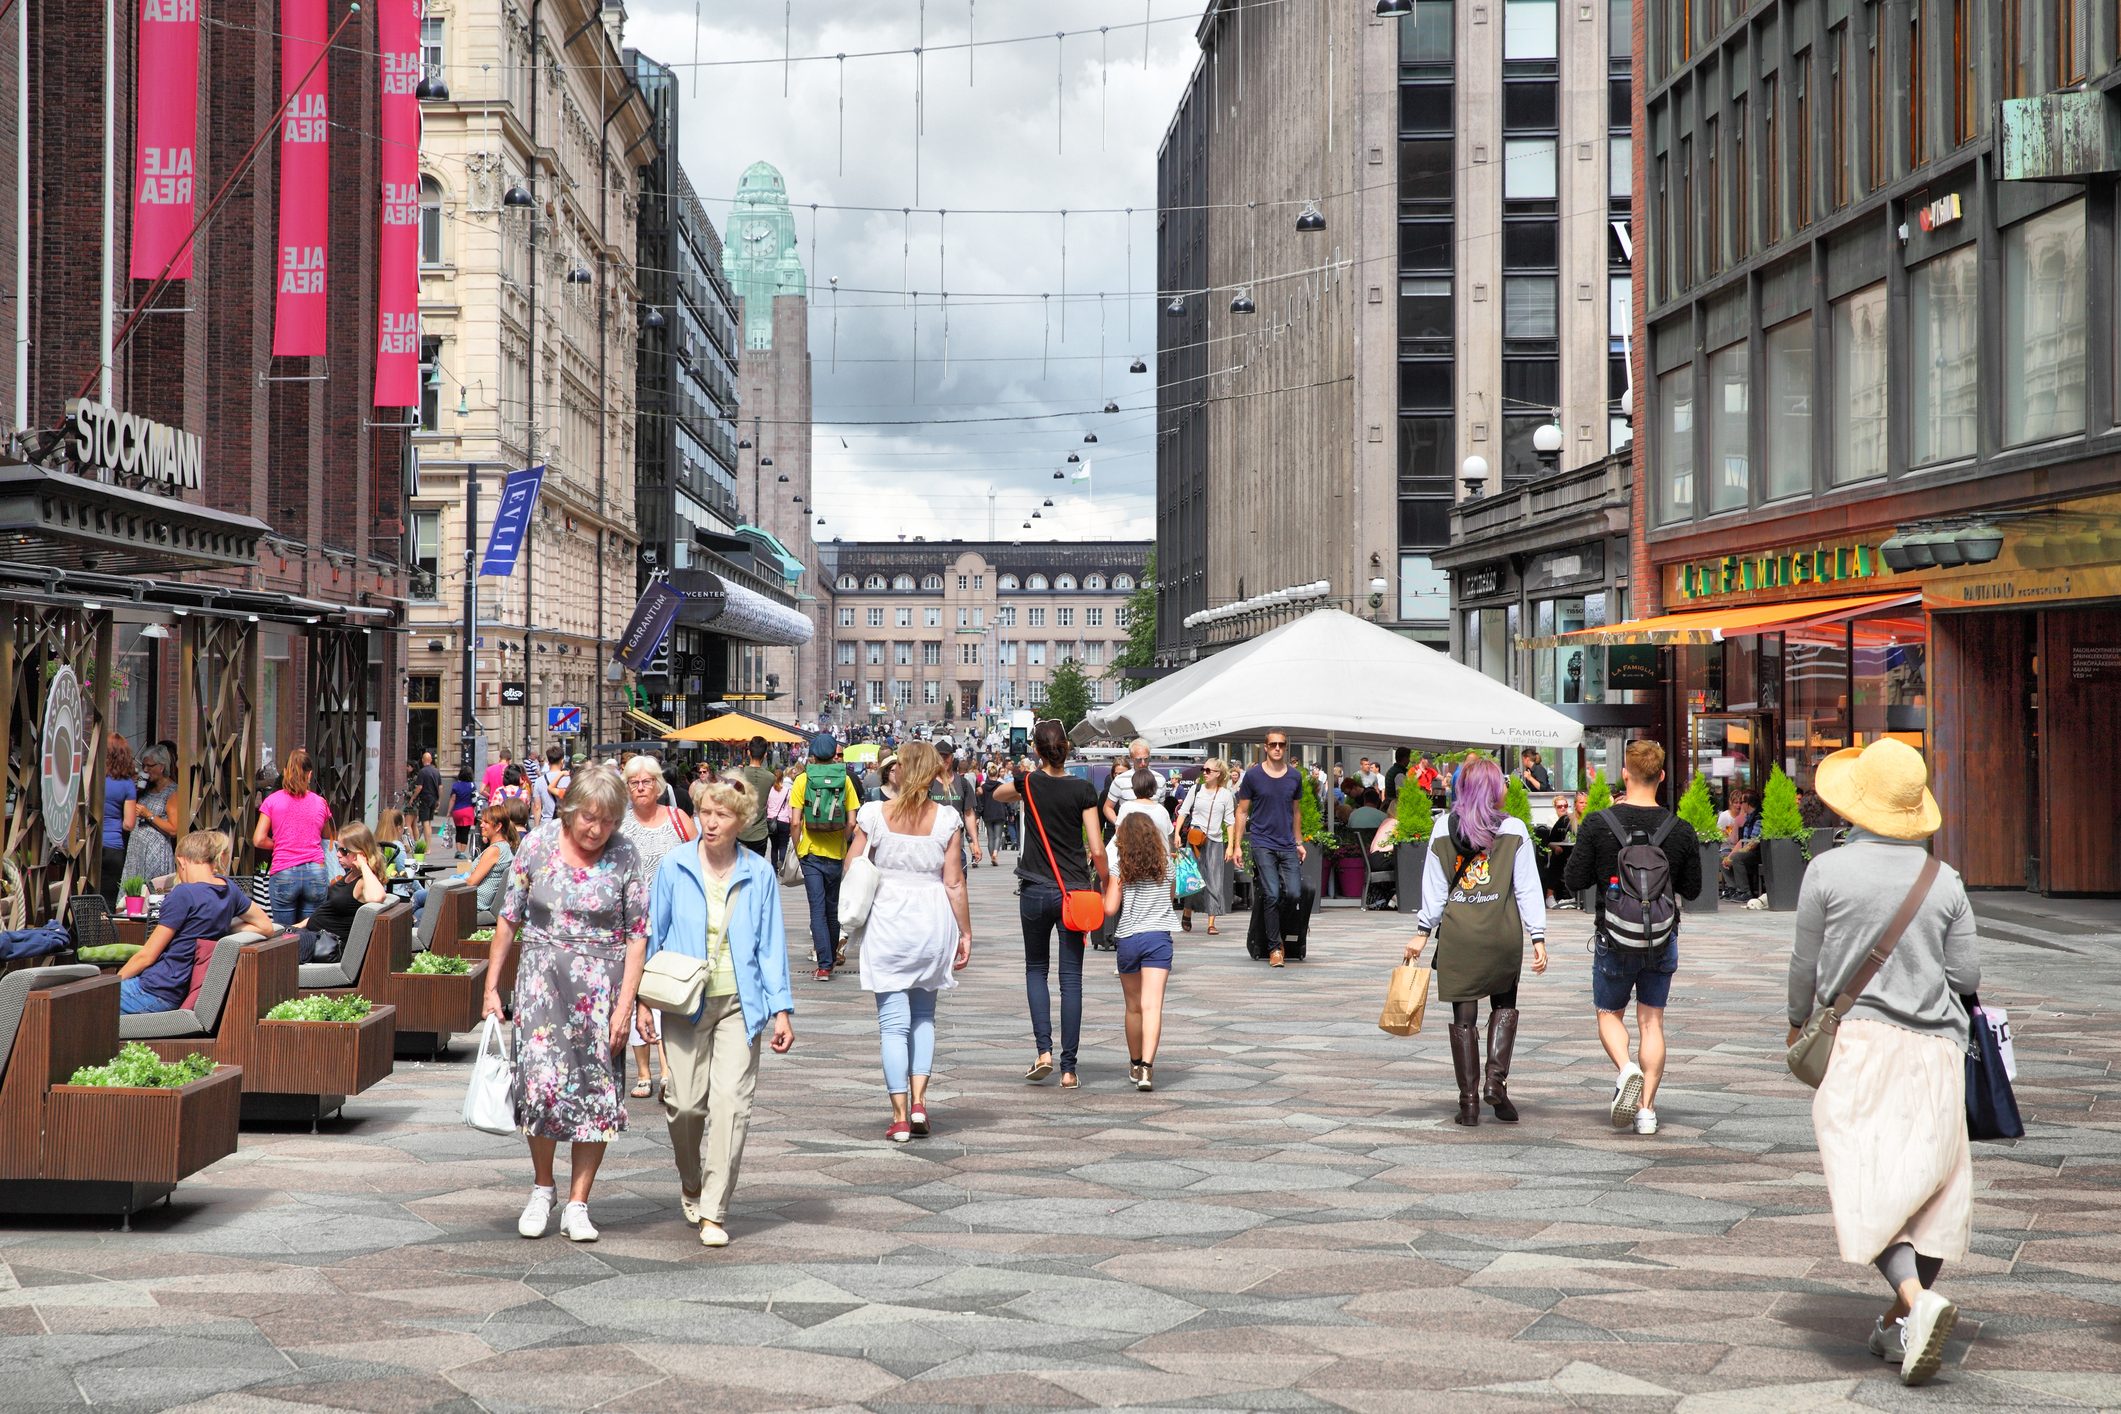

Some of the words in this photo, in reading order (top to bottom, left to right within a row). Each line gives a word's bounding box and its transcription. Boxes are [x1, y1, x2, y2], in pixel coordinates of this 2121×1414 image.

[76, 397, 202, 490] STOCKMANN
[492, 488, 527, 553] EVLI
[1682, 564, 1712, 600] LA
[1721, 544, 1871, 594] FAMIGLIA
[628, 593, 667, 648] GARANTUM
[1622, 664, 1655, 677] FAMIGLIA
[503, 687, 523, 698] elisa
[1160, 720, 1222, 737] TOMMASI
[1491, 727, 1506, 735] LA
[1509, 727, 1560, 738] FAMIGLIA
